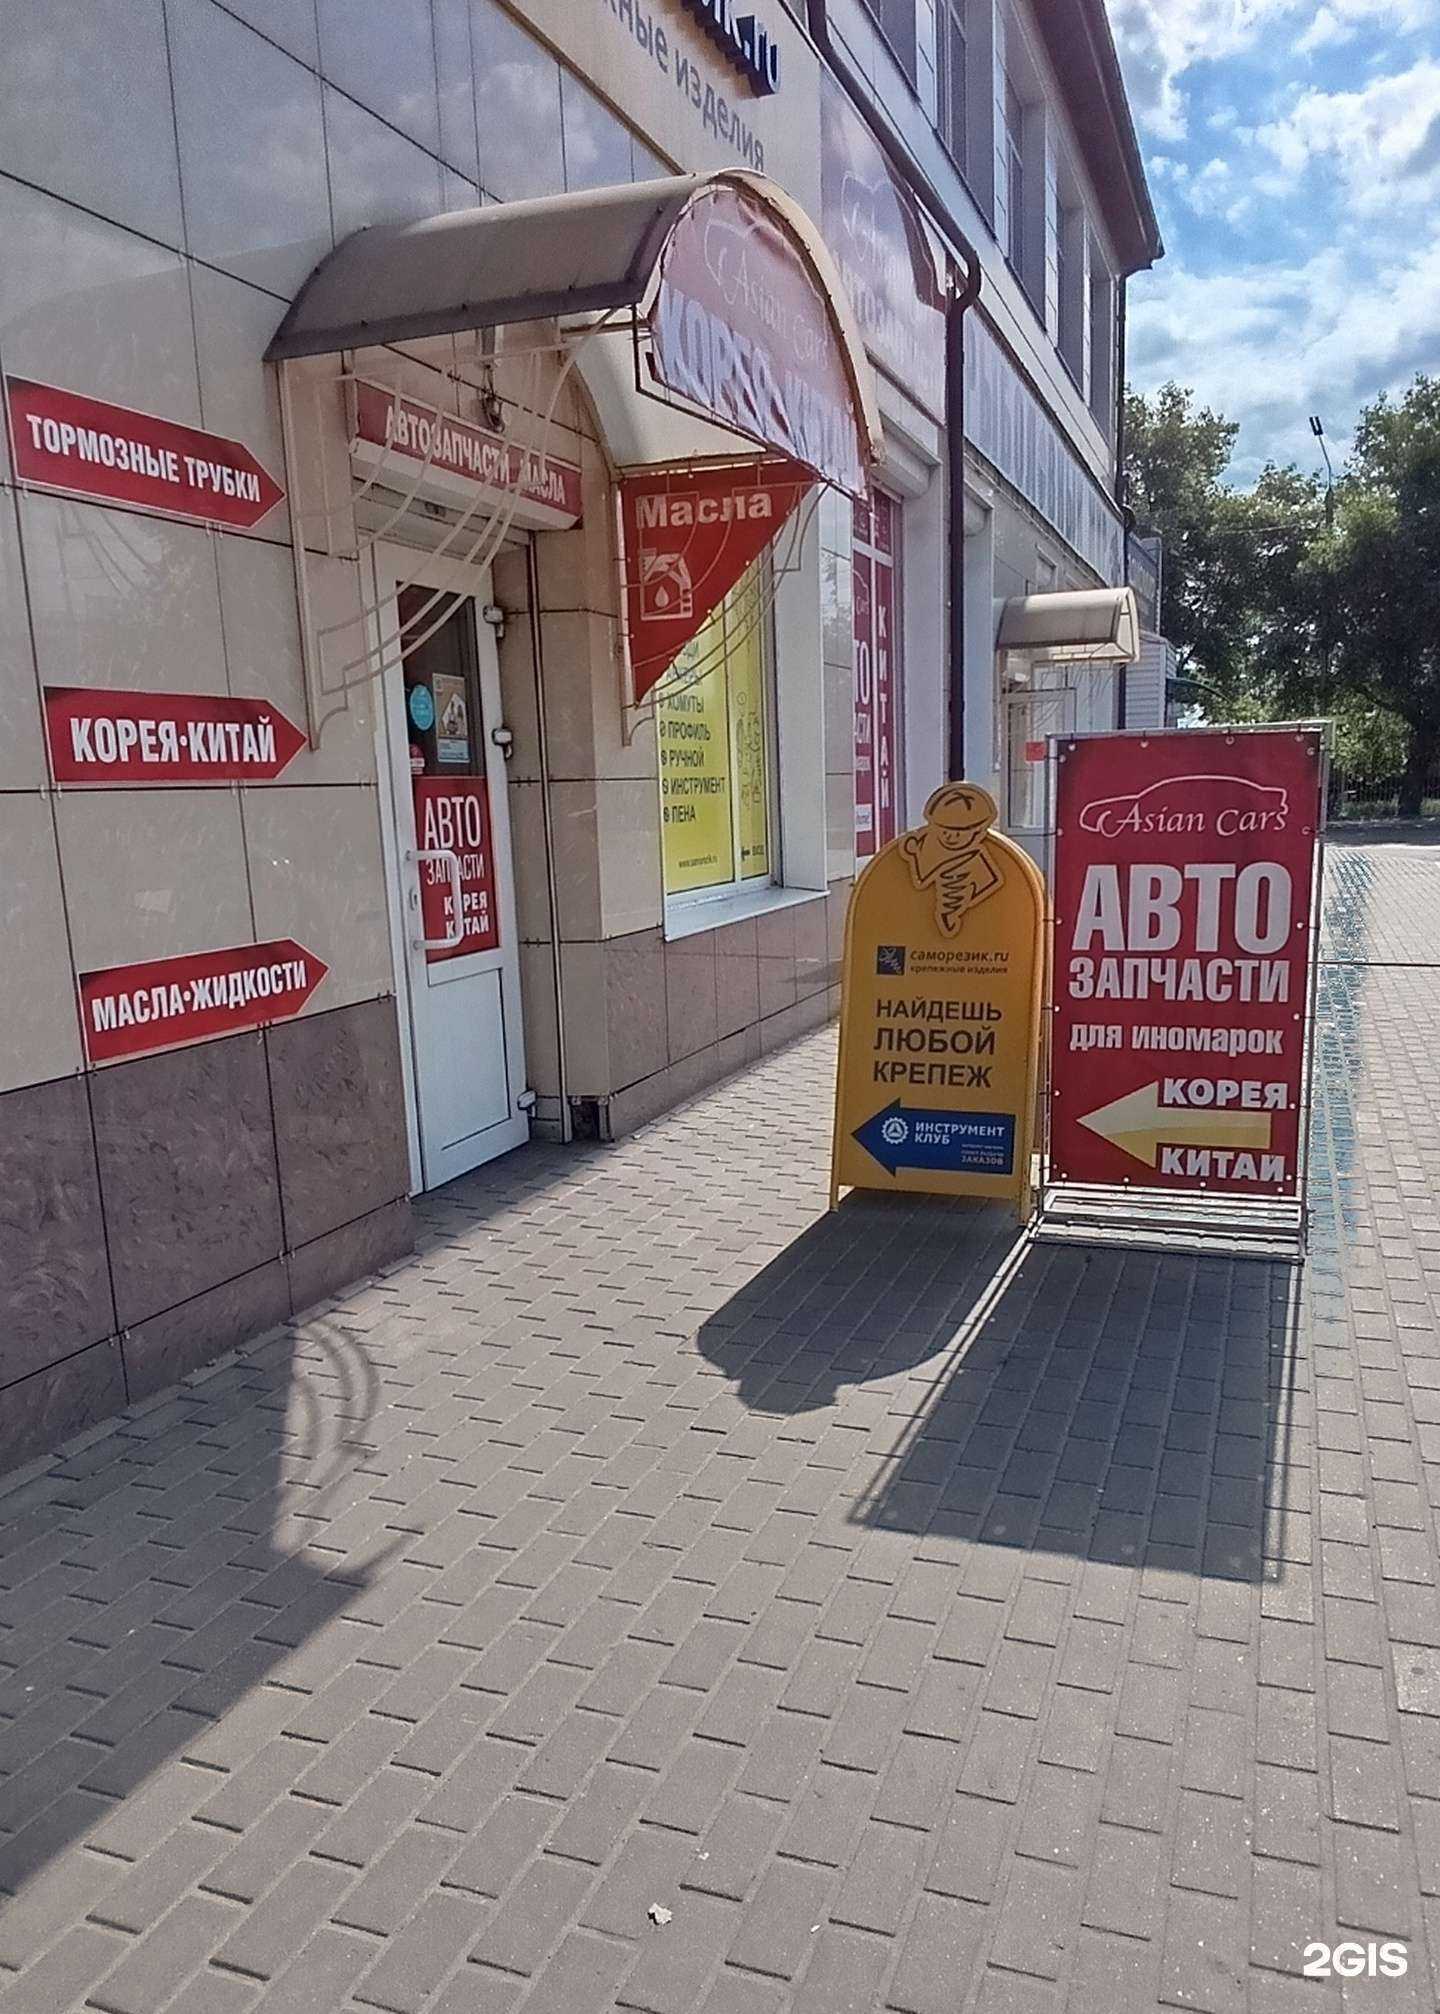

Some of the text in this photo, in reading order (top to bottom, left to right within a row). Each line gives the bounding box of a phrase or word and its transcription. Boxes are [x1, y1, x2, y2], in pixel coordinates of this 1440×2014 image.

[674, 48, 764, 172] изделия
[26, 413, 262, 504] ТОРМОЗНЫЕ ТРУБКИ
[385, 405, 510, 484] АВТОЗАПЧАСТИ
[635, 492, 773, 530] Масла
[668, 720, 711, 742] ПРОФИЛЬ
[669, 746, 705, 768] РУЧНОЙ
[670, 776, 726, 795] ИНСТРУМЕНТ
[423, 795, 482, 850] АВТО
[671, 804, 697, 824] ПЕНА
[1100, 800, 1289, 838] Asian Cars
[425, 852, 485, 886] ЗАПАСТИ
[443, 890, 488, 916] КРЕЯ
[1071, 861, 1293, 955] АВТО
[445, 911, 490, 940] КТАЙ
[910, 950, 1010, 963] саморезик.ru
[910, 964, 1008, 975] крепежные изделия
[1069, 956, 1291, 1003] ЗАПЧАСТИ
[876, 996, 1003, 1023] НАЙДЕШЬ
[873, 1025, 996, 1056] ЛЮБОЙ
[1070, 1023, 1284, 1057] для иномарок
[873, 1060, 993, 1089] КРЕПЕЖ
[1162, 1077, 1289, 1110] КОРЕЯ
[914, 1132, 951, 1145] КЛУБ
[915, 1121, 1006, 1137] ИНСТРУМЕНТ
